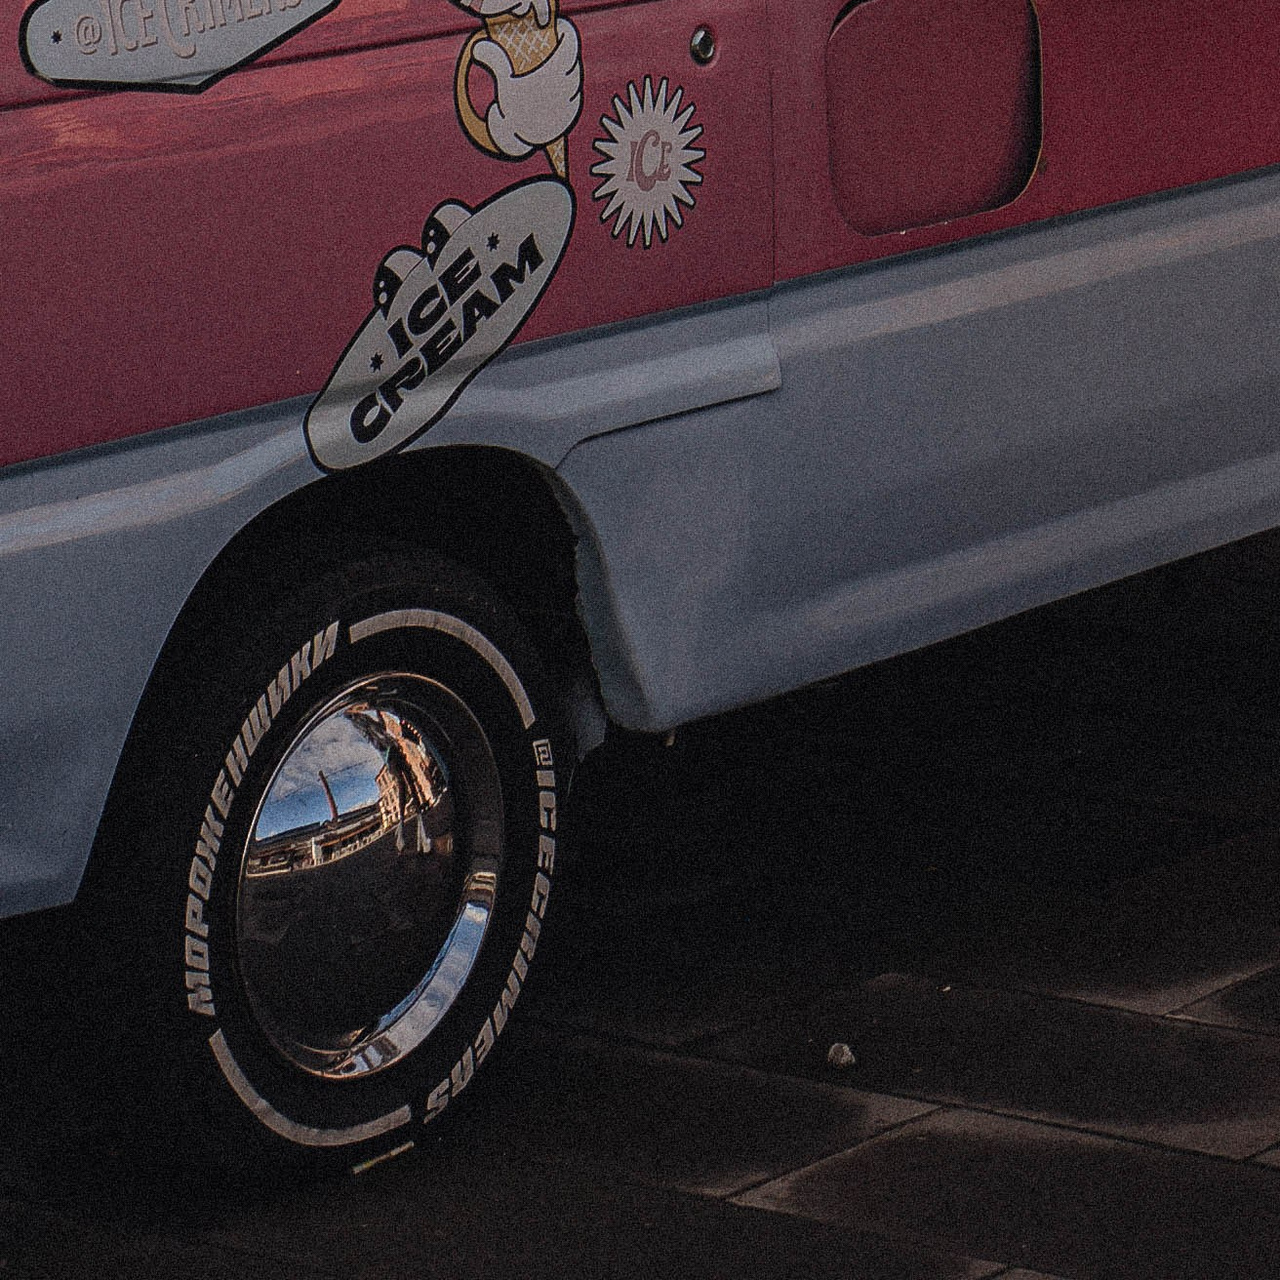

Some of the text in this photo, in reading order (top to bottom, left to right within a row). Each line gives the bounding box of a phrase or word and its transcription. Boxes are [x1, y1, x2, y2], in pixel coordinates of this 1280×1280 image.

[626, 129, 673, 192] ICE
[349, 233, 545, 445] CREAM
[394, 246, 482, 360] ICE
[186, 620, 340, 1016] МОРОЖЕНЩИКИ
